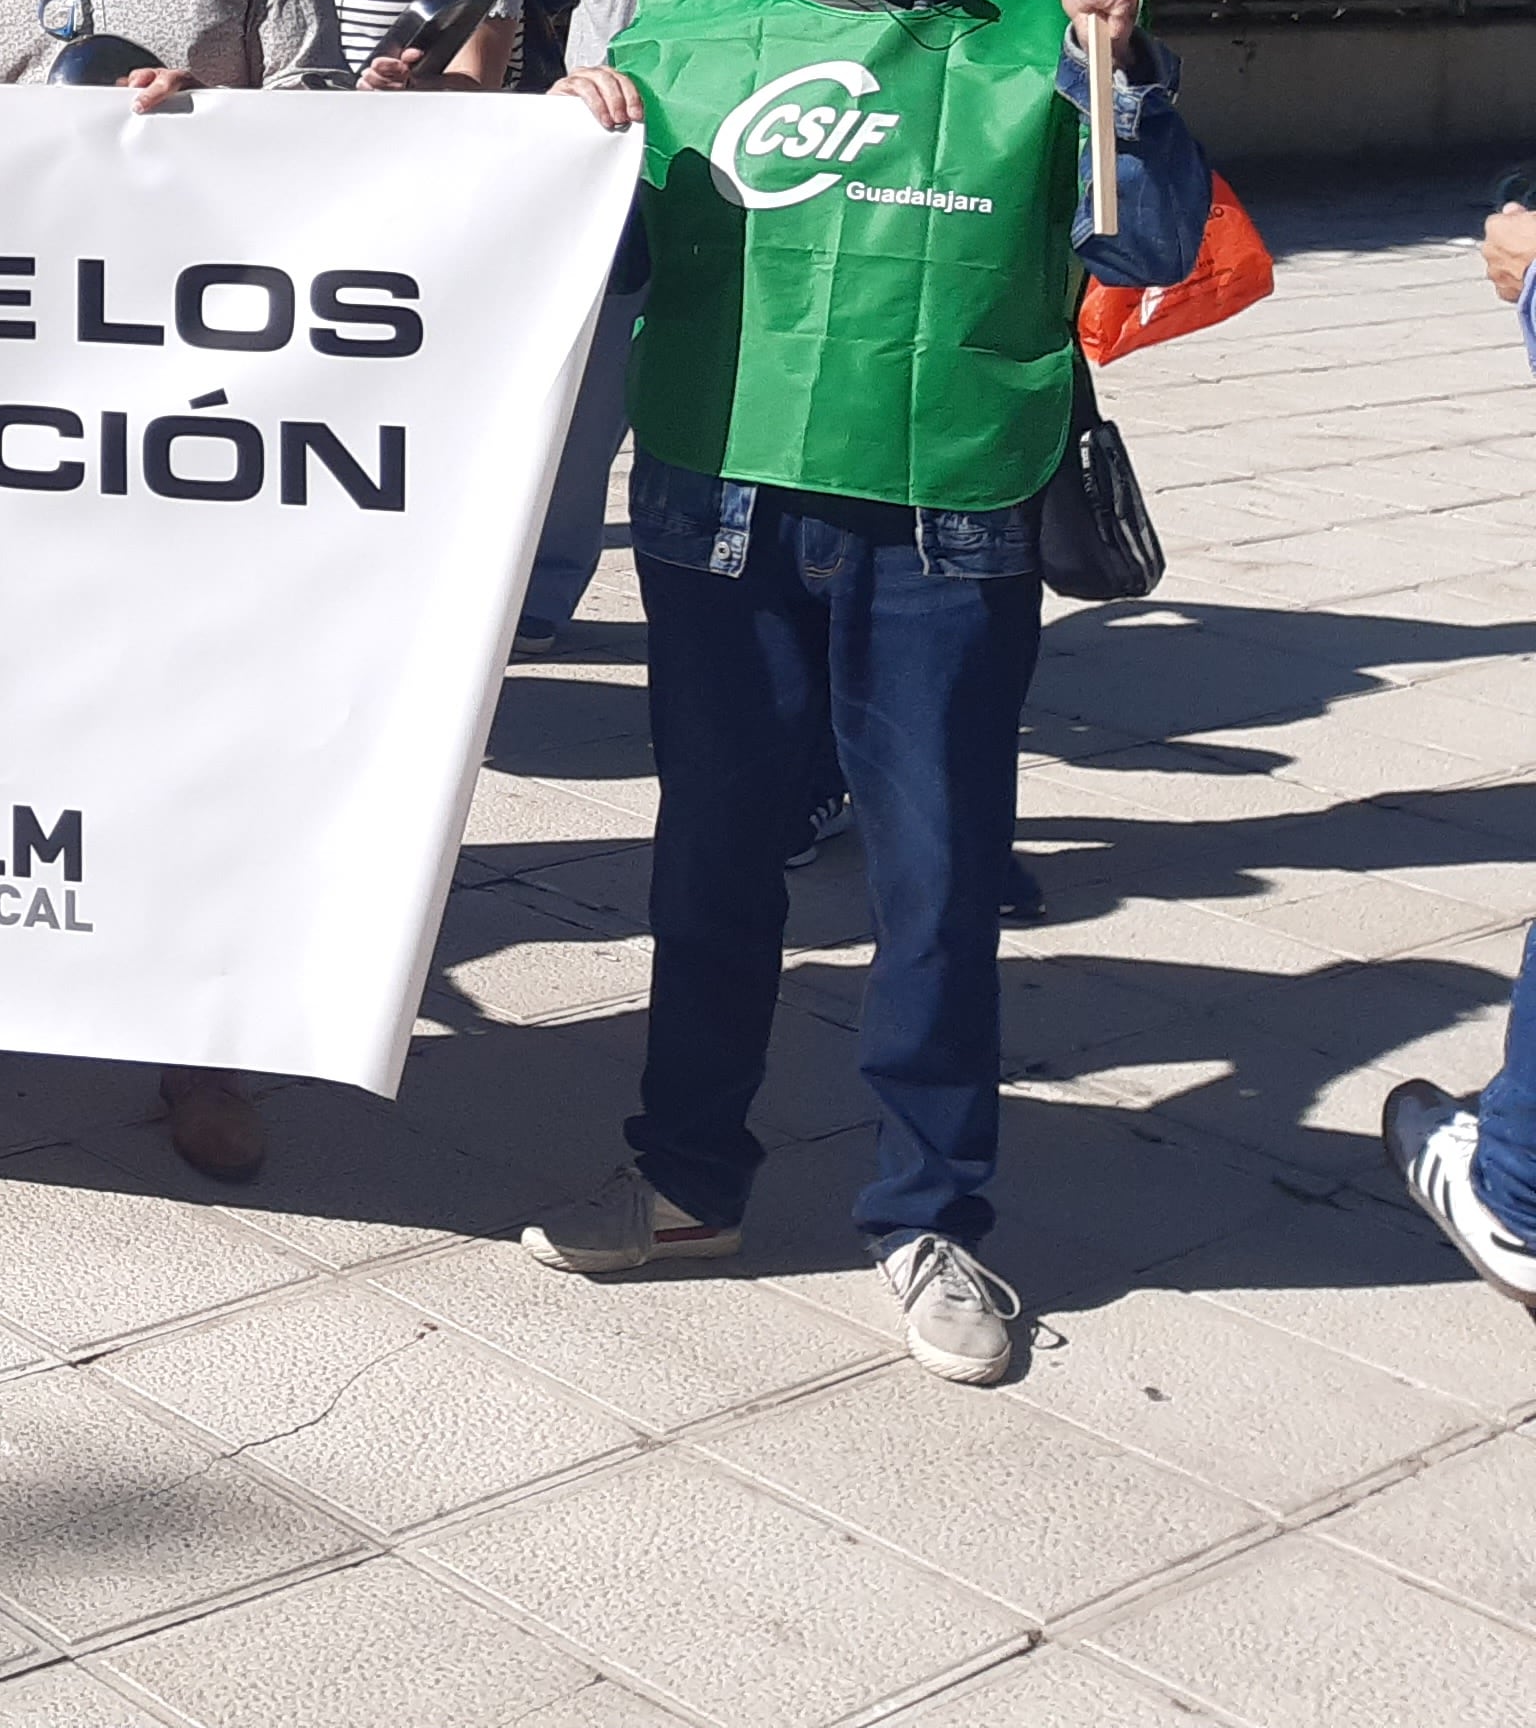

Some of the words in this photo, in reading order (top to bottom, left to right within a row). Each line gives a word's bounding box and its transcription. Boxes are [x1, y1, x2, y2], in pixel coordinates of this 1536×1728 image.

[745, 103, 900, 162] CSIF
[845, 180, 993, 215] Guadalajara
[77, 258, 424, 358] LOS
